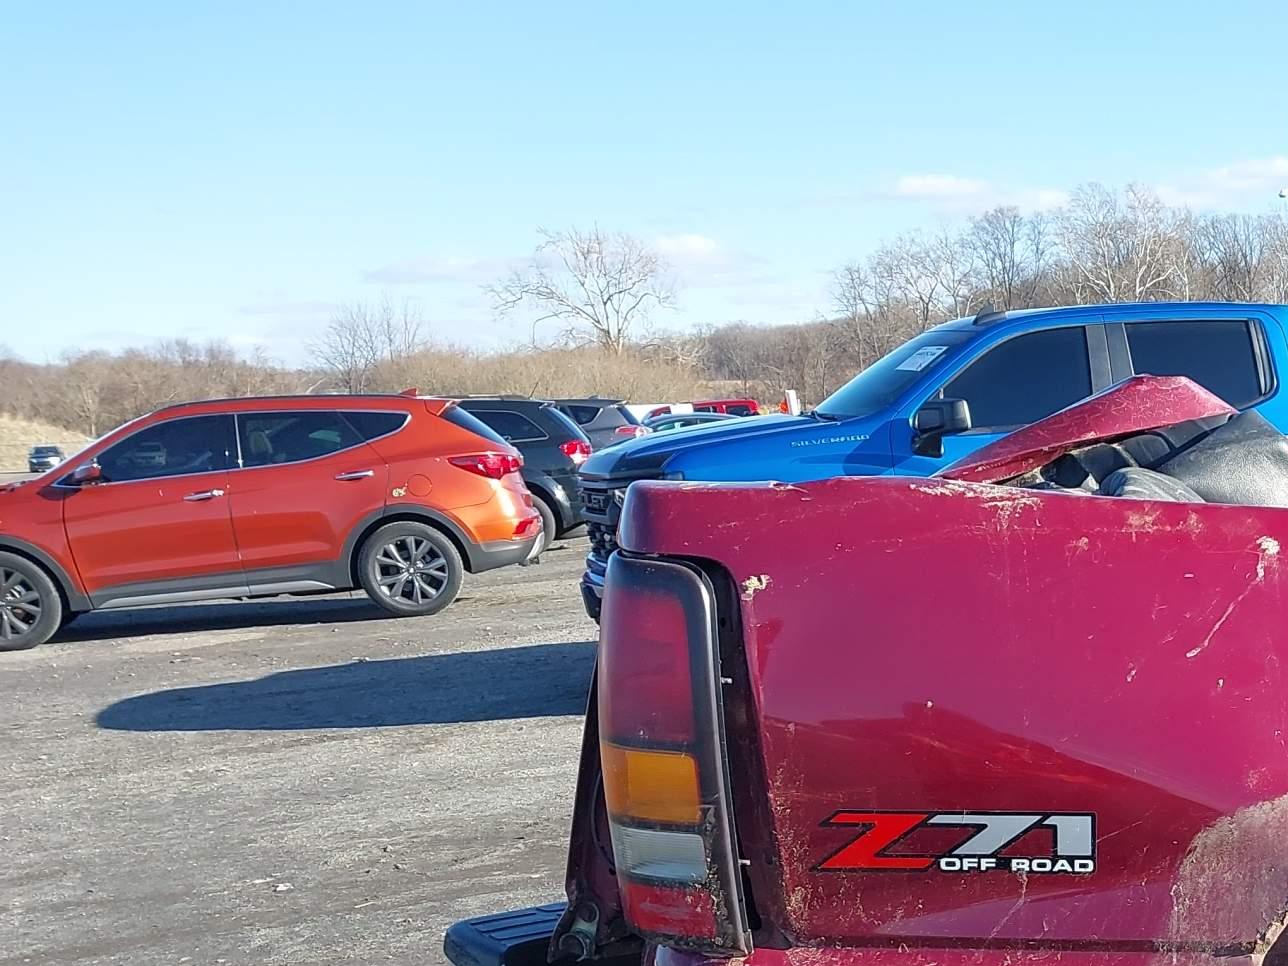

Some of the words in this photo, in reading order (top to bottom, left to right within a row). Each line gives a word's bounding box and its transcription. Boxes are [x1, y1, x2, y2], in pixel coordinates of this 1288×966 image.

[791, 434, 870, 447] SILVERADO
[819, 811, 1093, 869] Z71
[939, 857, 996, 871] OFF
[1011, 858, 1094, 872] ROAD
